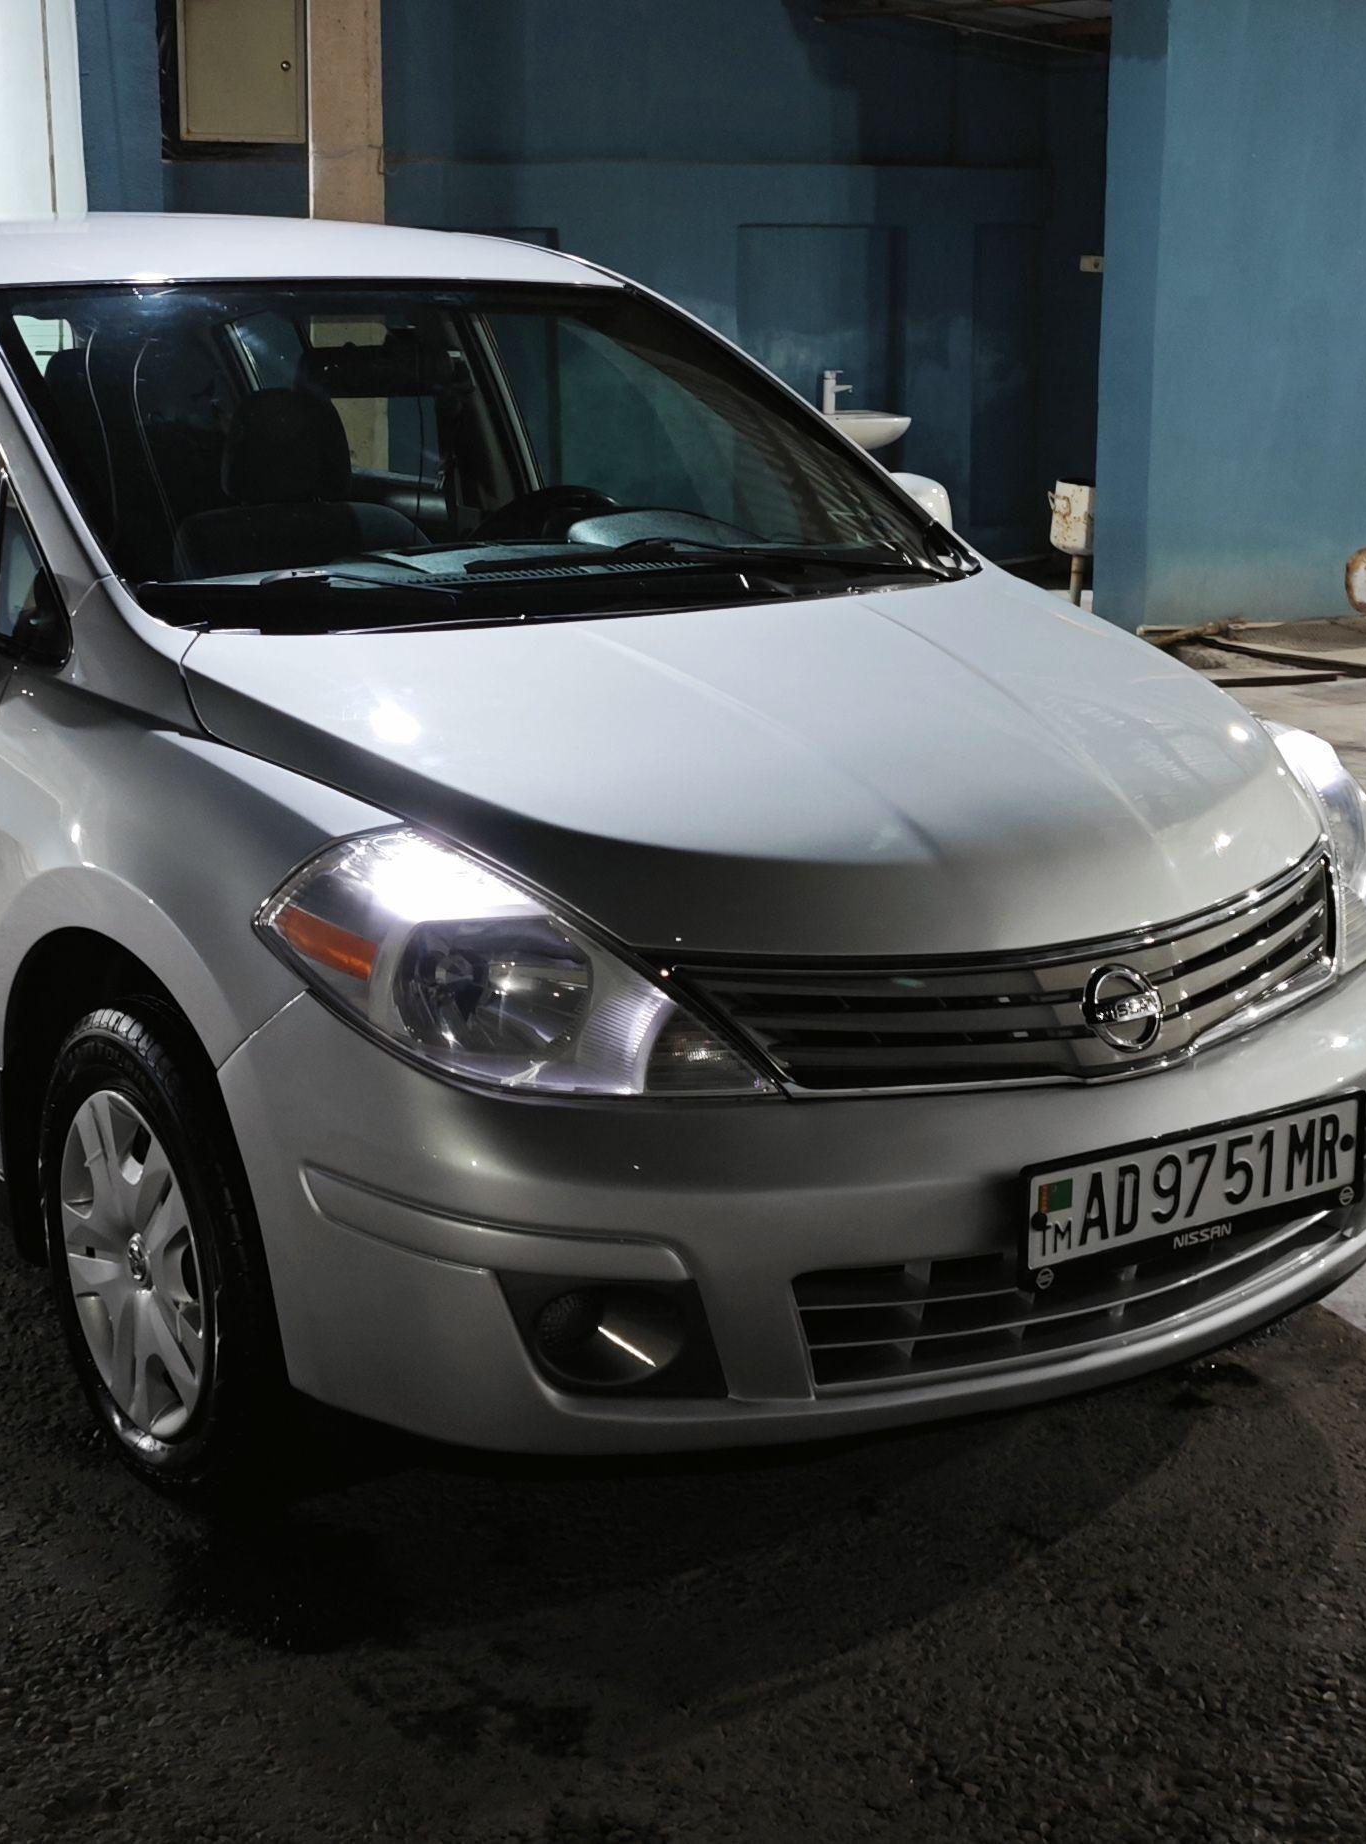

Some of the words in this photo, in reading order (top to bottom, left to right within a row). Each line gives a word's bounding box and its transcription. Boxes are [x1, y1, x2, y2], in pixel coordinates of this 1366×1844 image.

[1079, 1163, 1140, 1247] AD
[1284, 1112, 1340, 1192] MR
[1172, 1222, 1233, 1250] NISSAN
